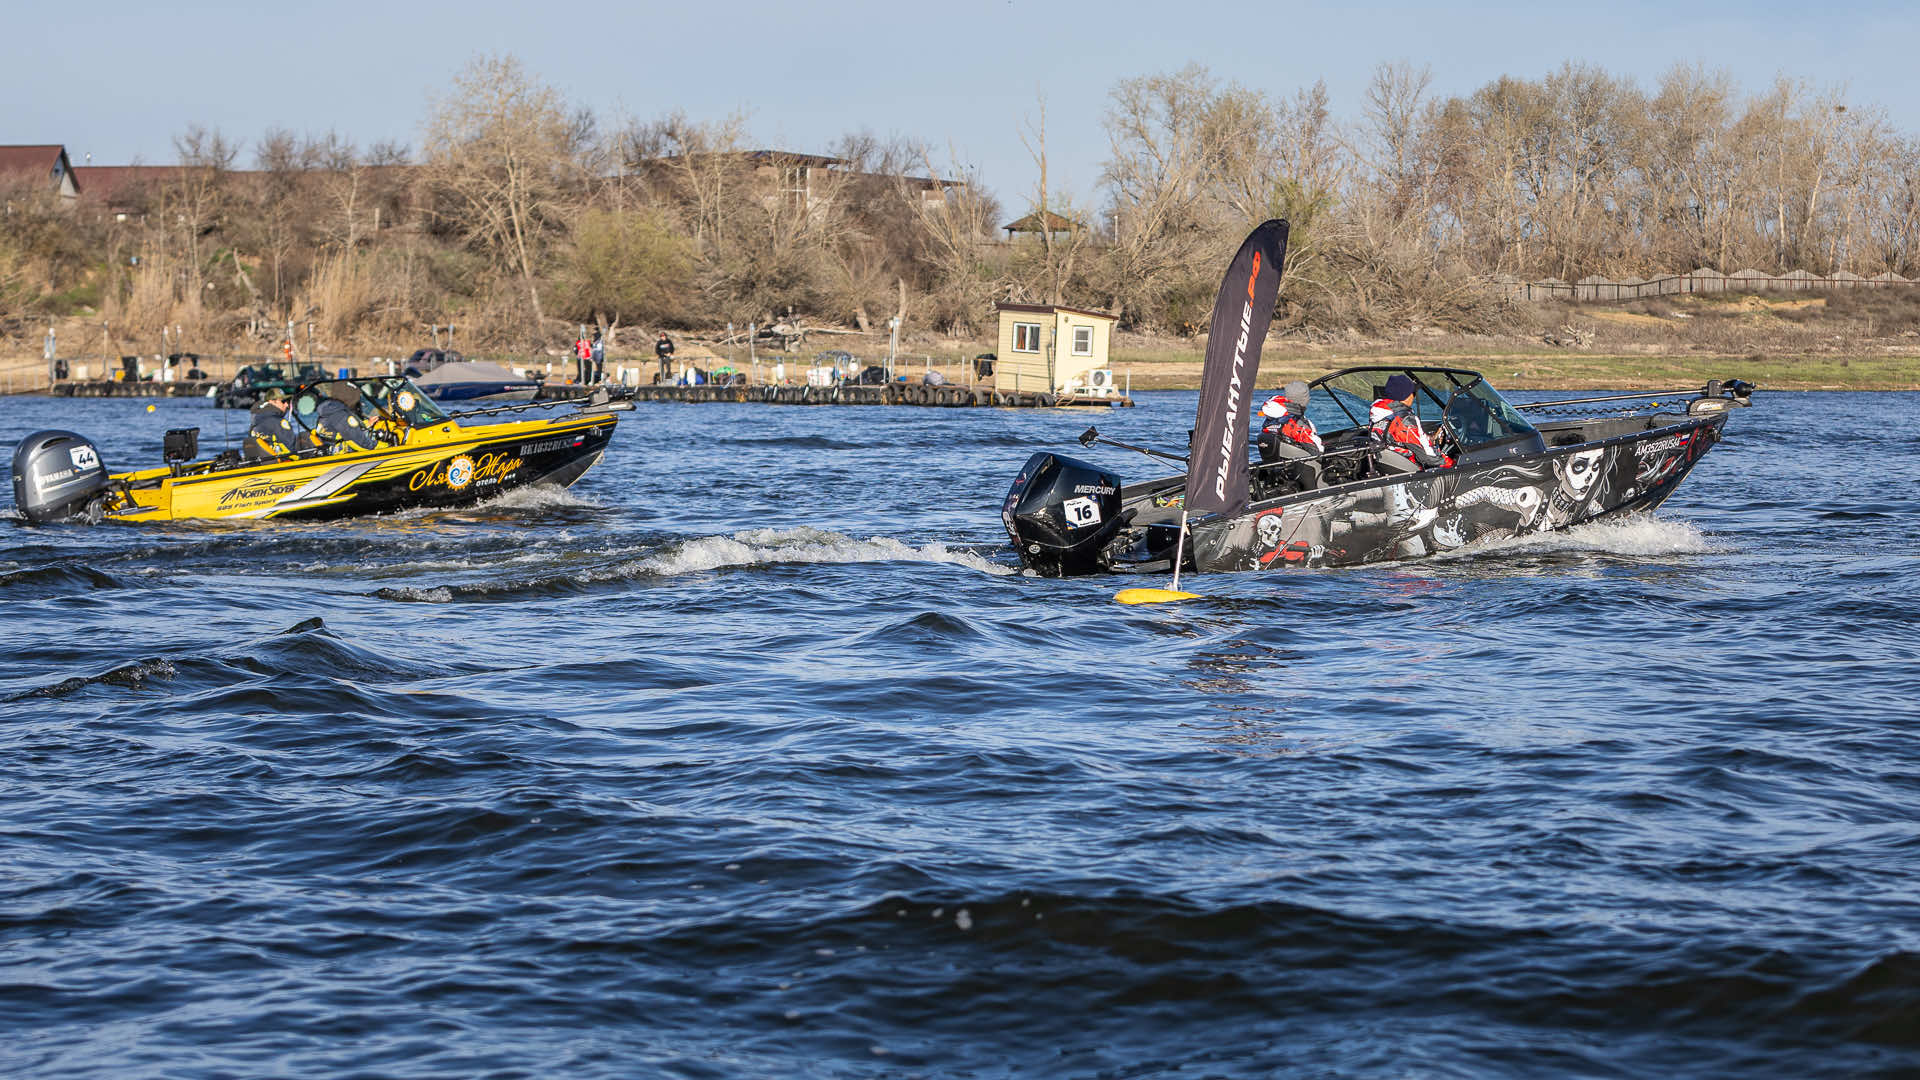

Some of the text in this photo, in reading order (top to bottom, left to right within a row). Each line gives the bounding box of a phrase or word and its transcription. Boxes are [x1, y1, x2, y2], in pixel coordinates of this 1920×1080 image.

[79, 452, 94, 465] 44
[1074, 484, 1116, 495] MERCURY
[1074, 504, 1092, 521] 16
